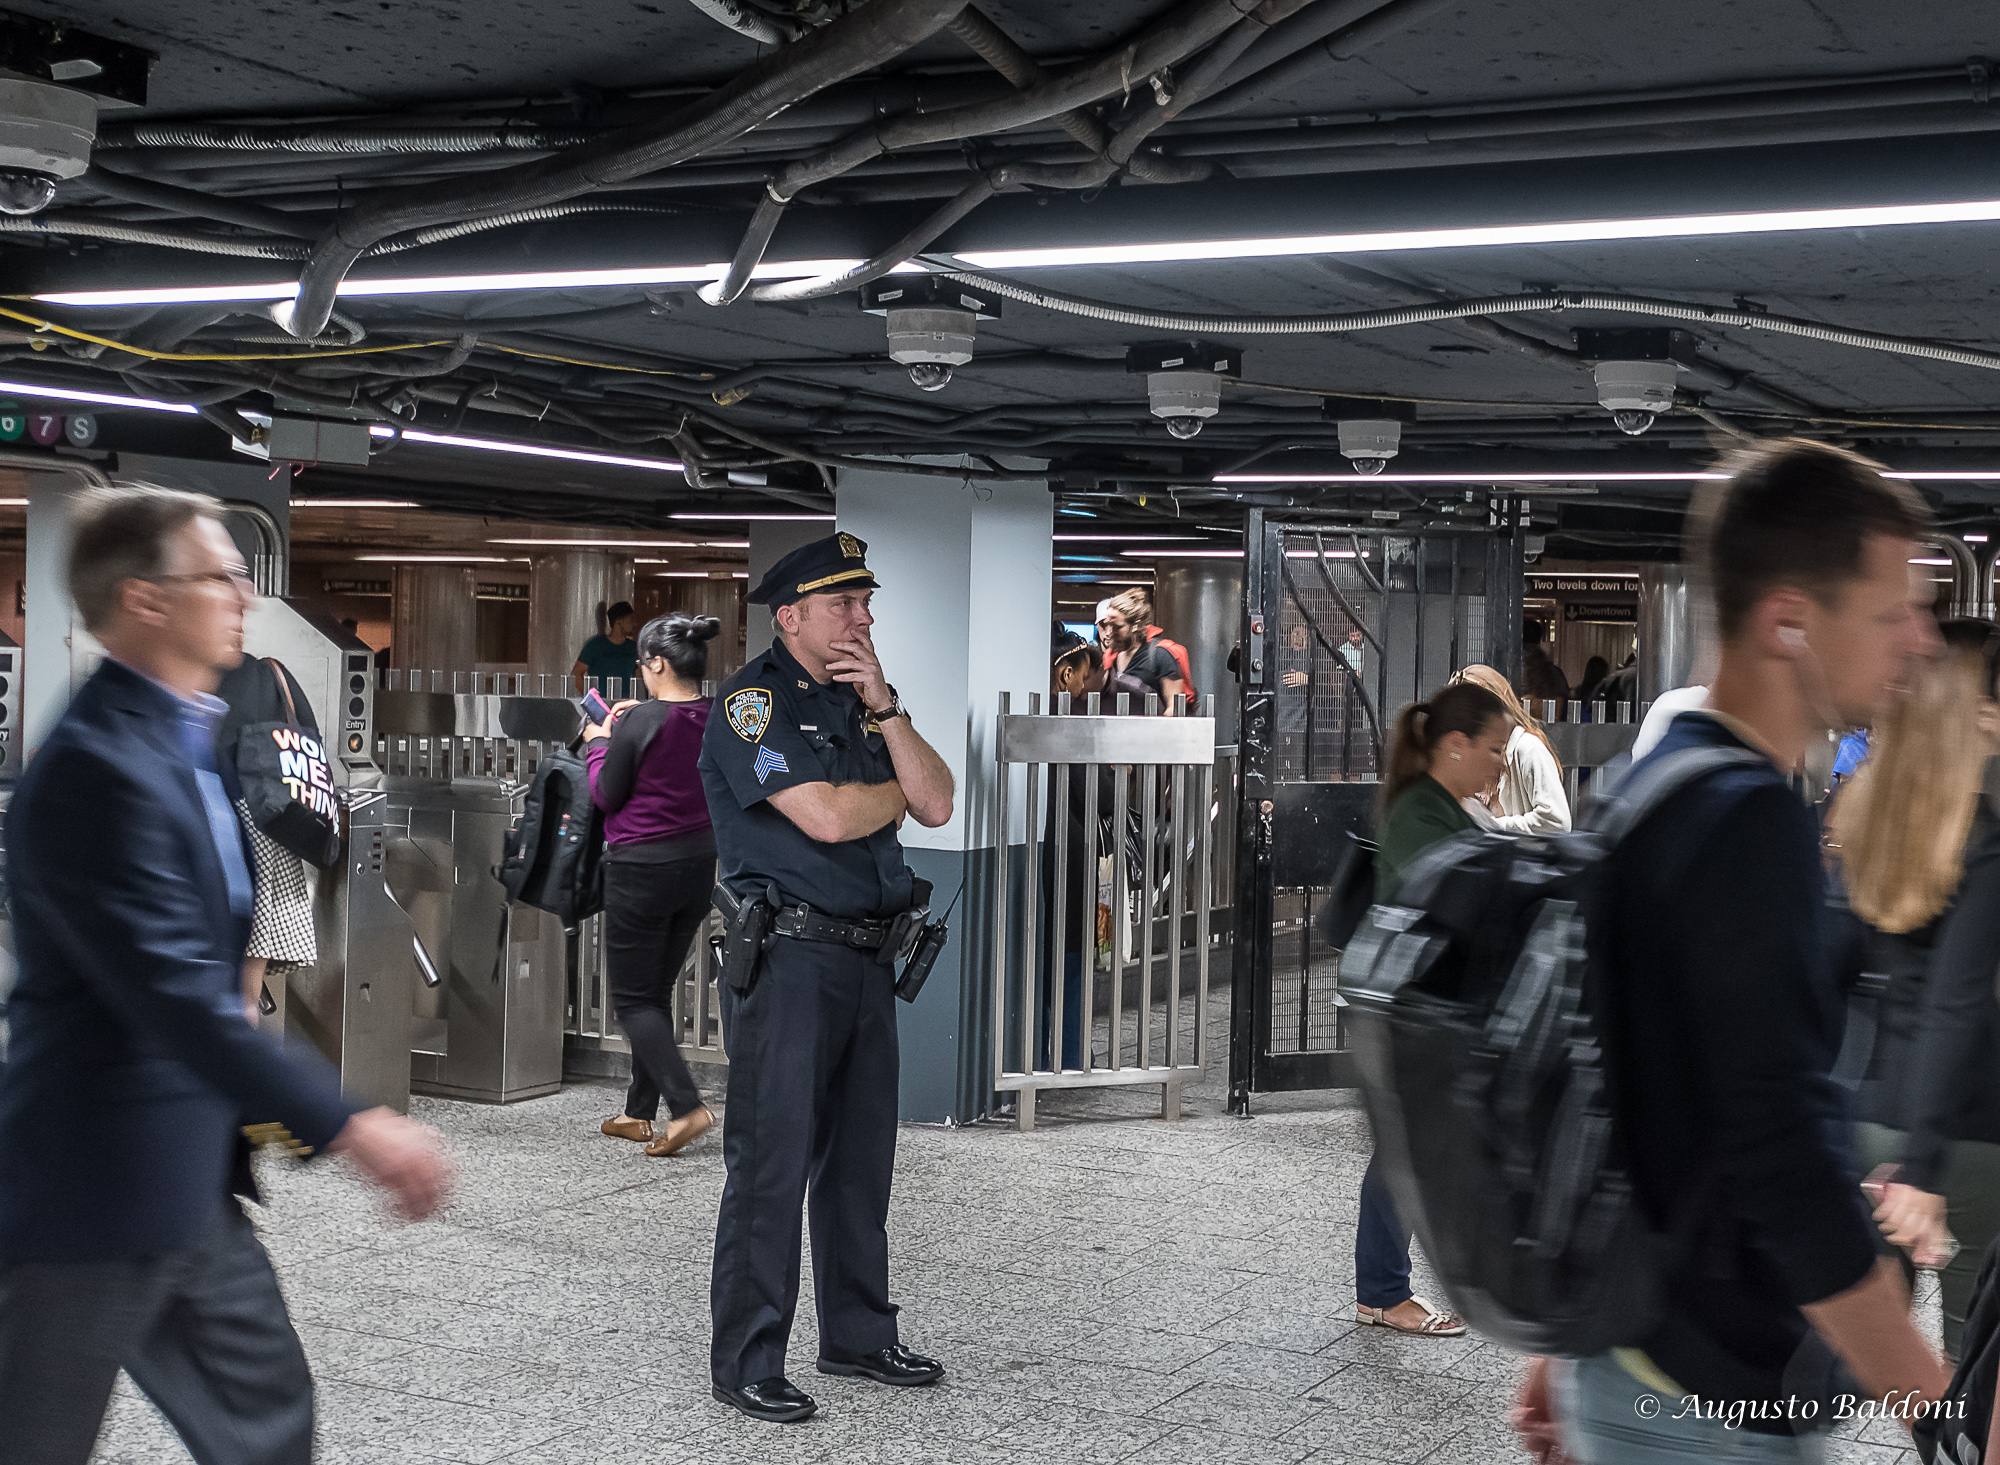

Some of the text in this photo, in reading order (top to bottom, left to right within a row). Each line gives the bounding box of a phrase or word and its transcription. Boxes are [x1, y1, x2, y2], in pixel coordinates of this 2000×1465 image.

[39, 415, 53, 437] 7
[73, 416, 89, 440] S
[1533, 579, 1554, 590] Two
[1557, 580, 1587, 590] levels
[1591, 580, 1620, 591] down
[1579, 606, 1631, 617] Downtown
[735, 691, 758, 702] POLICE
[730, 696, 767, 712] DEPARTMENT
[762, 705, 770, 722] YORK
[345, 720, 365, 731] Entry
[731, 717, 742, 731] CITY
